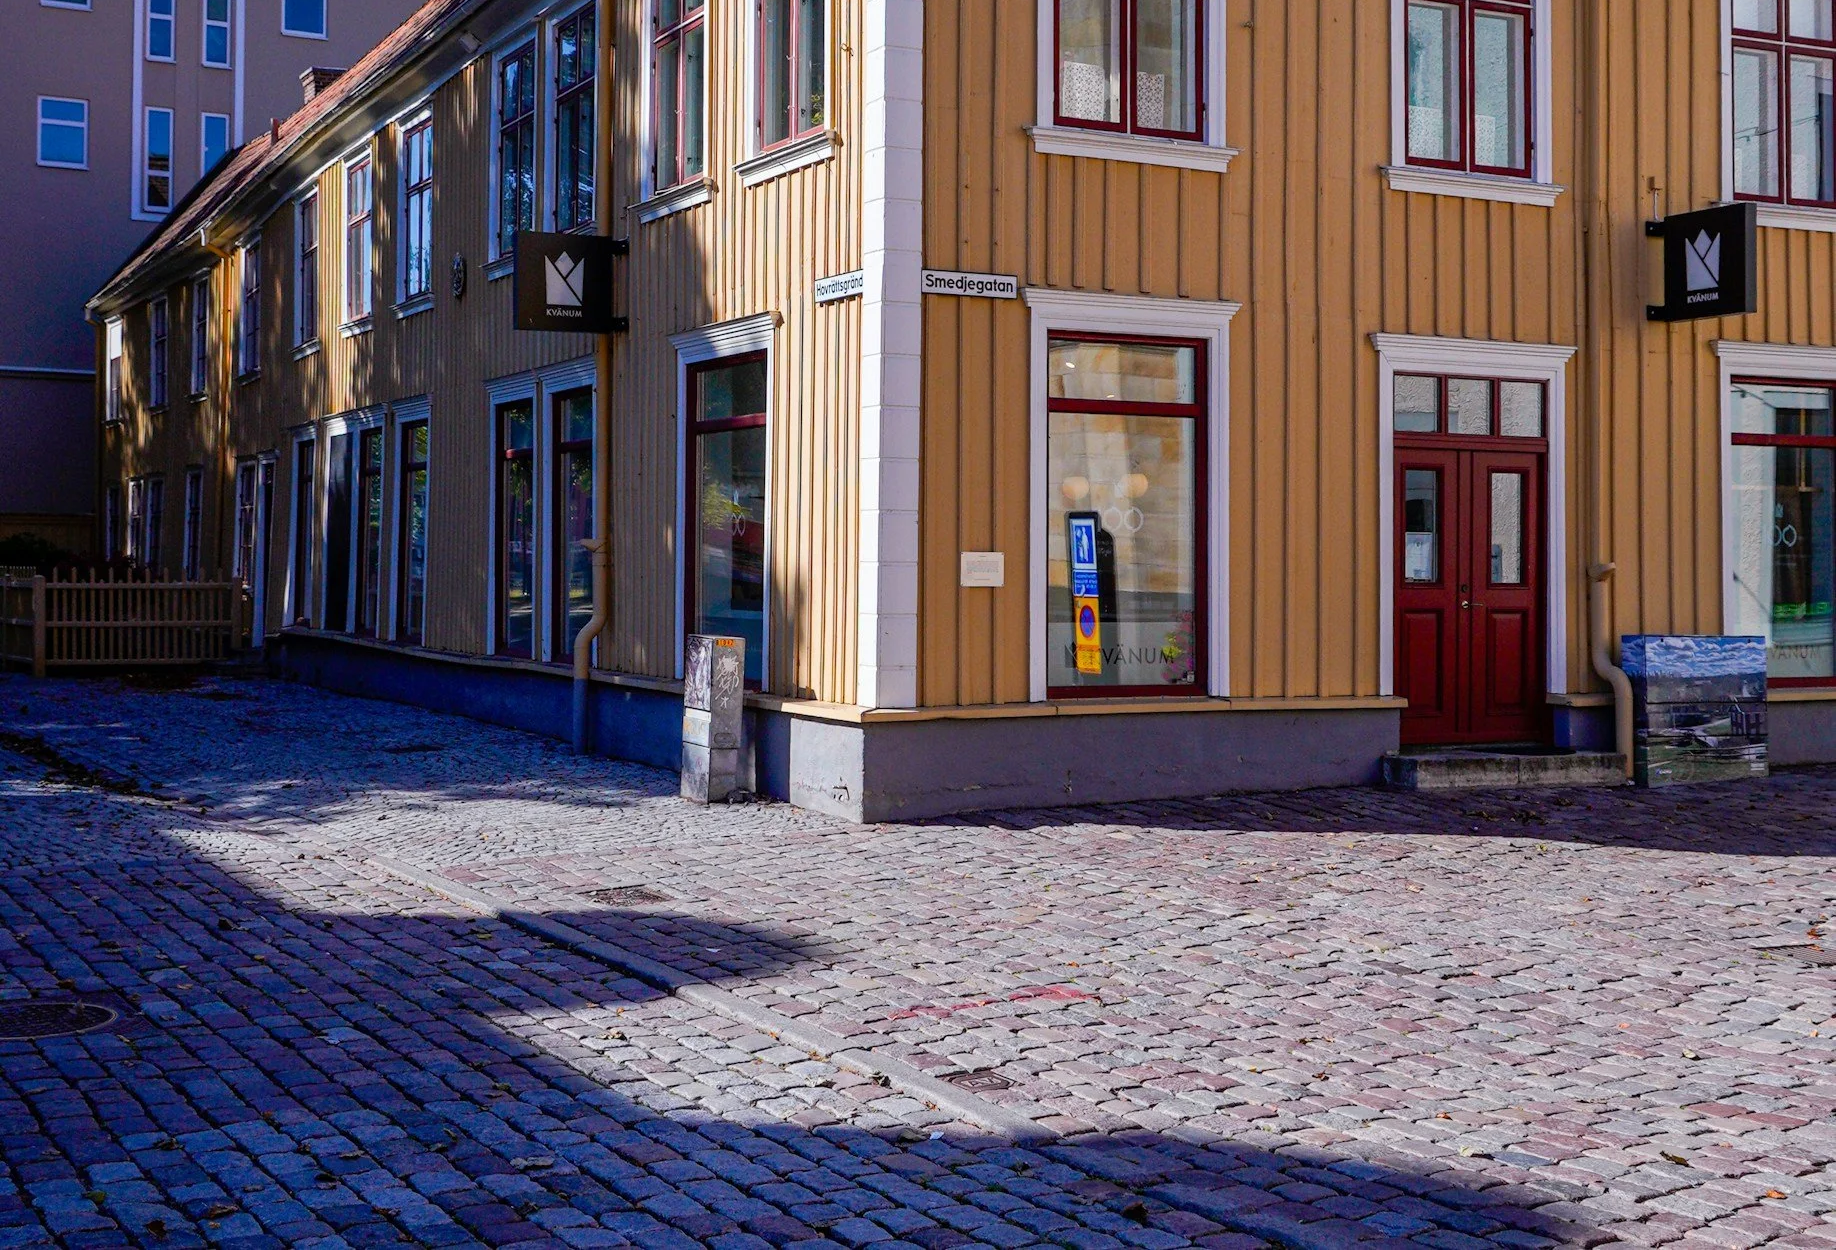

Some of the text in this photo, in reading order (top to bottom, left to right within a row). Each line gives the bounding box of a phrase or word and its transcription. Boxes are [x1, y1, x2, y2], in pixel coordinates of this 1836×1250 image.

[816, 273, 863, 296] Hovrättsgränd
[925, 274, 1013, 295] Smedjegatan
[1687, 293, 1718, 303] KVÄNUM
[546, 308, 582, 318] KVÄNUM
[1102, 644, 1174, 665] VÄNUM
